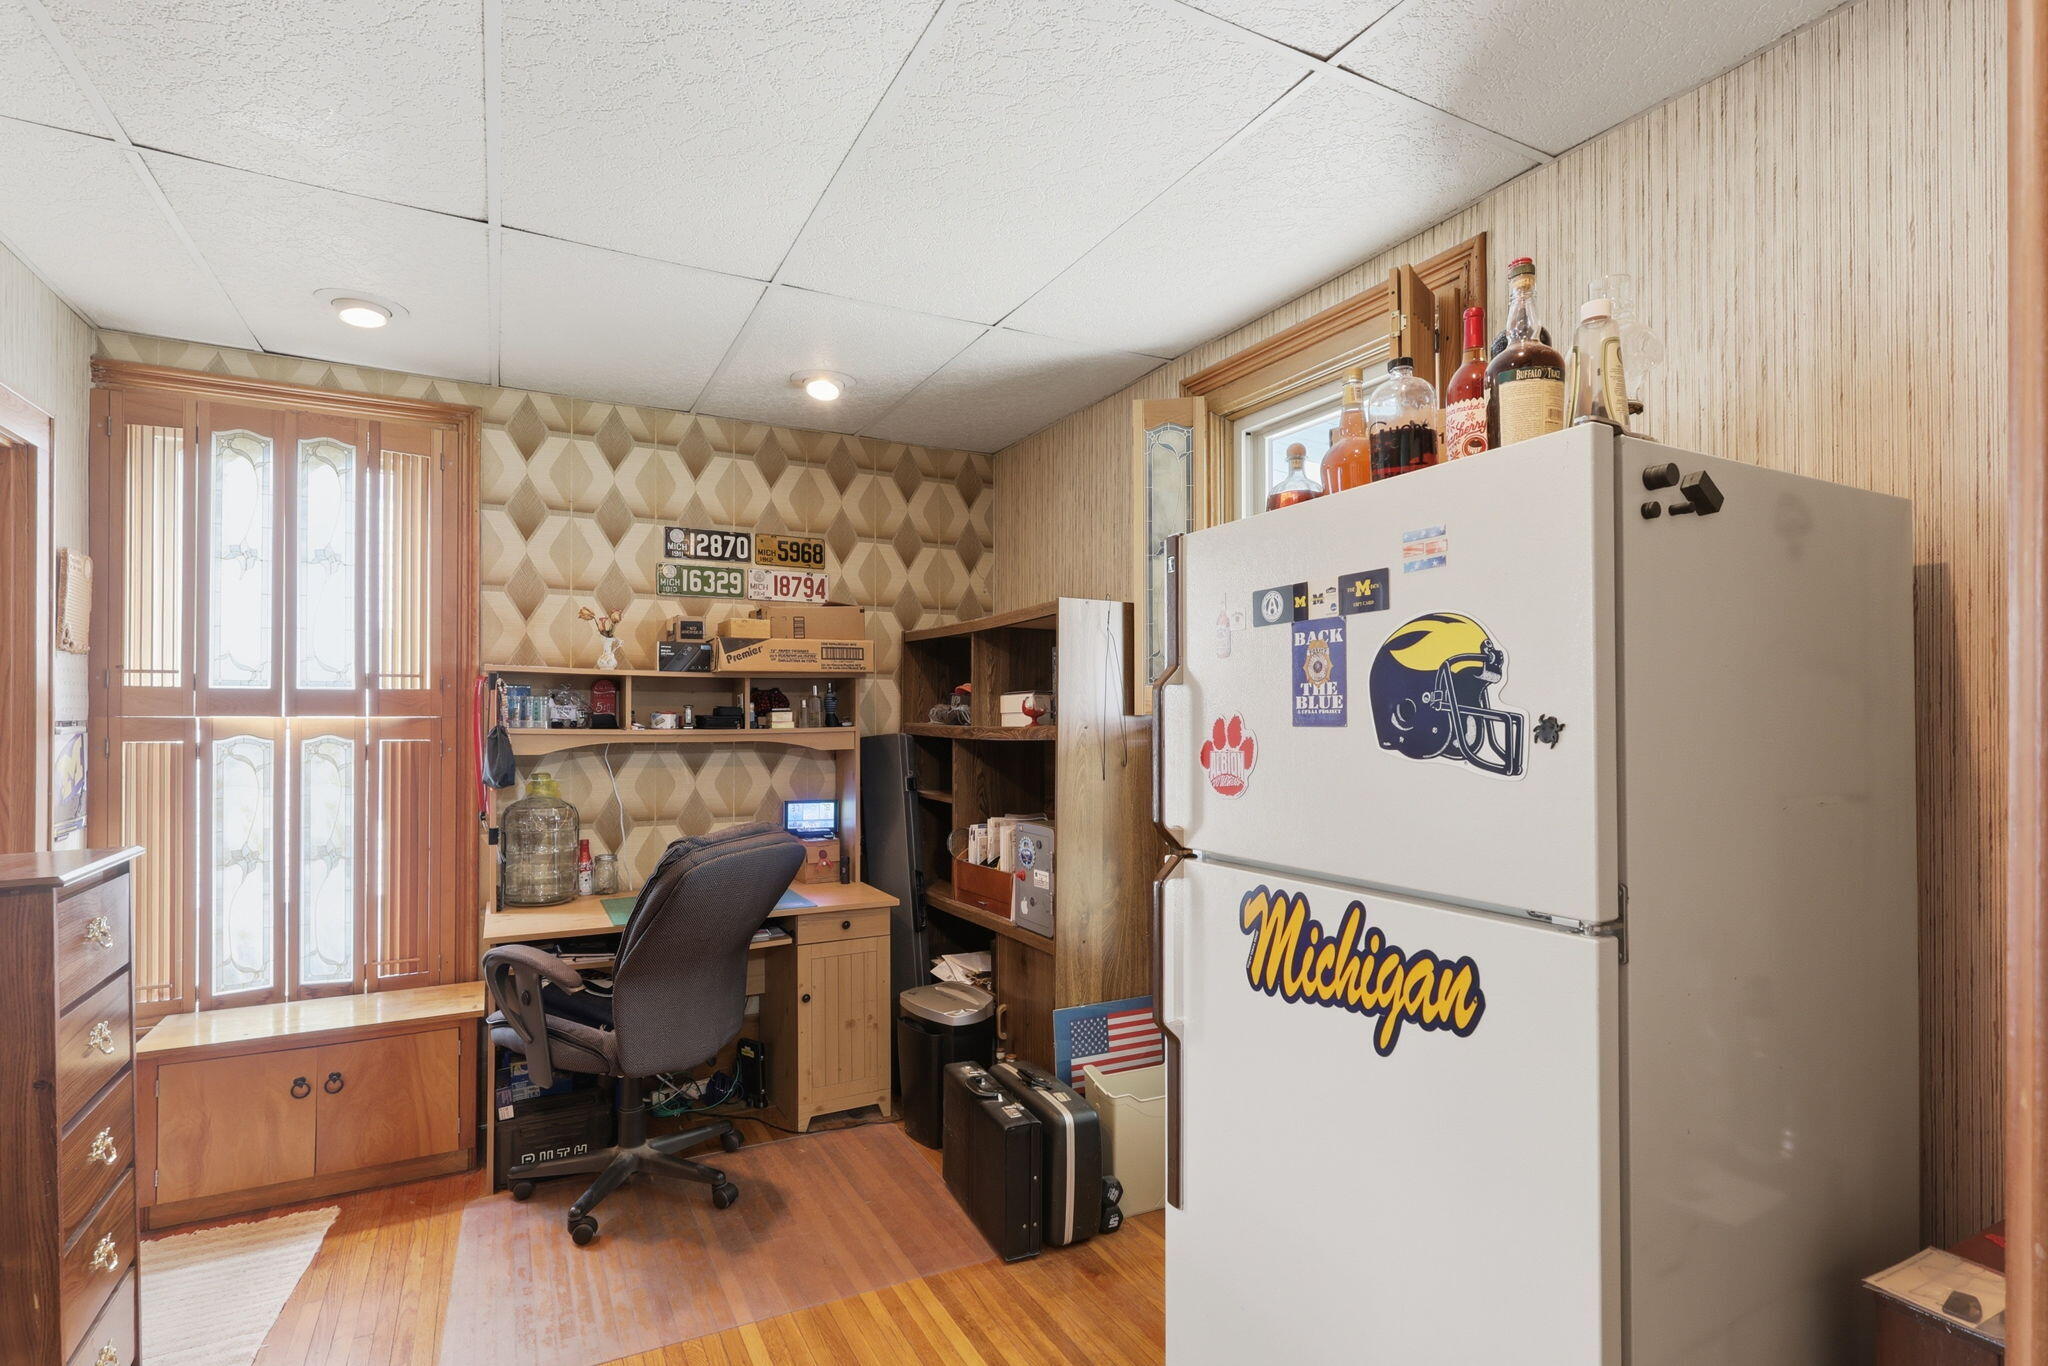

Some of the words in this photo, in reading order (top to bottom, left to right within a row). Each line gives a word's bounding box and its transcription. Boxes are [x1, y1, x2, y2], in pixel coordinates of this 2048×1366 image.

[1516, 369, 1542, 380] BUFFALO
[667, 542, 688, 551] MICH
[689, 532, 749, 559] 12870
[758, 549, 776, 557] MICH
[777, 540, 823, 564] 5968
[660, 578, 680, 587] MICH
[682, 568, 742, 595] 16329
[750, 583, 768, 591] MICH
[773, 575, 826, 599] 18794
[1355, 578, 1371, 597] M
[1294, 596, 1306, 608] M
[1294, 628, 1343, 646] BACK
[726, 646, 762, 664] Premier
[1300, 681, 1338, 696] THE
[1296, 695, 1344, 710] BLUE
[1242, 888, 1482, 1052] Michigan
